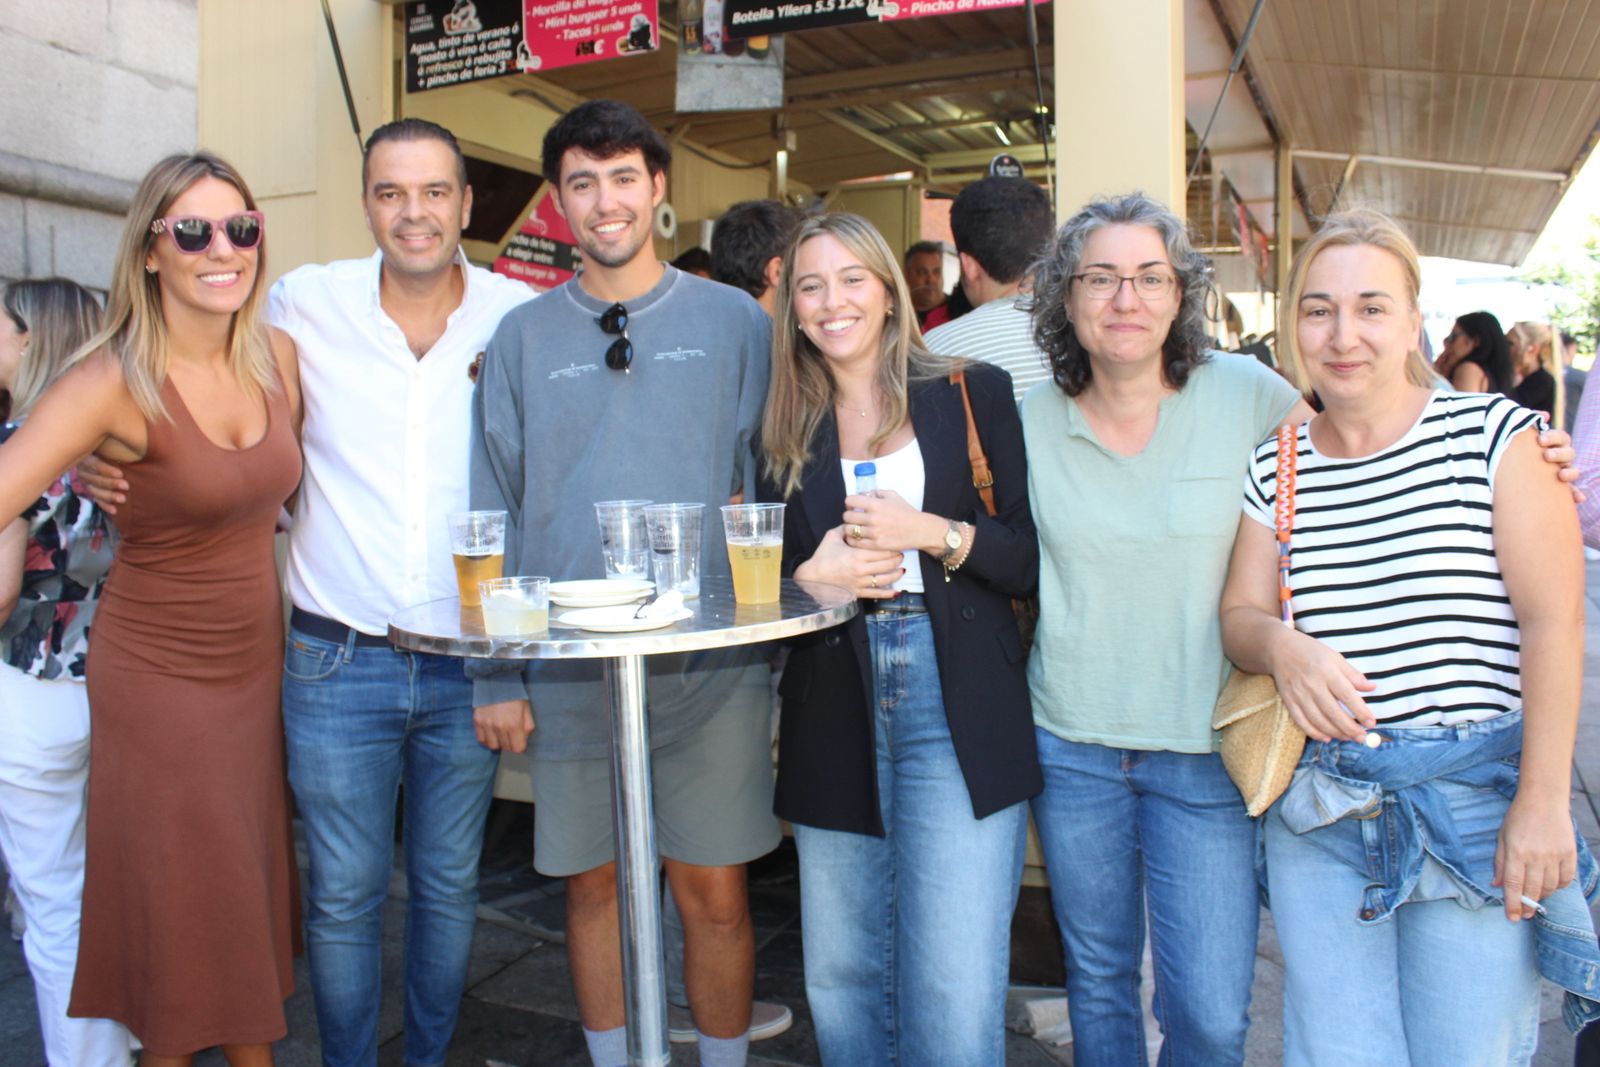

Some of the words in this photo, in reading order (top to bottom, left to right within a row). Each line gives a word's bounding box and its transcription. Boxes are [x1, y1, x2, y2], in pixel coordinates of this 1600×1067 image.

[532, 1, 571, 17] Morcilla
[545, 15, 567, 29] Mini
[568, 9, 609, 24] burguer
[618, 2, 642, 16] unds
[732, 8, 775, 25] Botella
[777, 4, 813, 18] Yllera
[814, 0, 836, 13] 5.5
[911, 1, 954, 14] Pincho
[957, 0, 974, 8] de
[410, 42, 437, 55] Agua,
[438, 36, 460, 49] tinto
[462, 33, 475, 43] de
[476, 26, 511, 40] verano
[563, 26, 592, 40] Tacos
[418, 51, 447, 64] mosto
[457, 45, 478, 57] vino
[487, 38, 512, 51] caña
[426, 60, 464, 74] refresco
[473, 50, 513, 65] rebujito
[426, 74, 459, 89] pincho
[460, 69, 473, 80] de
[474, 64, 497, 78] feria
